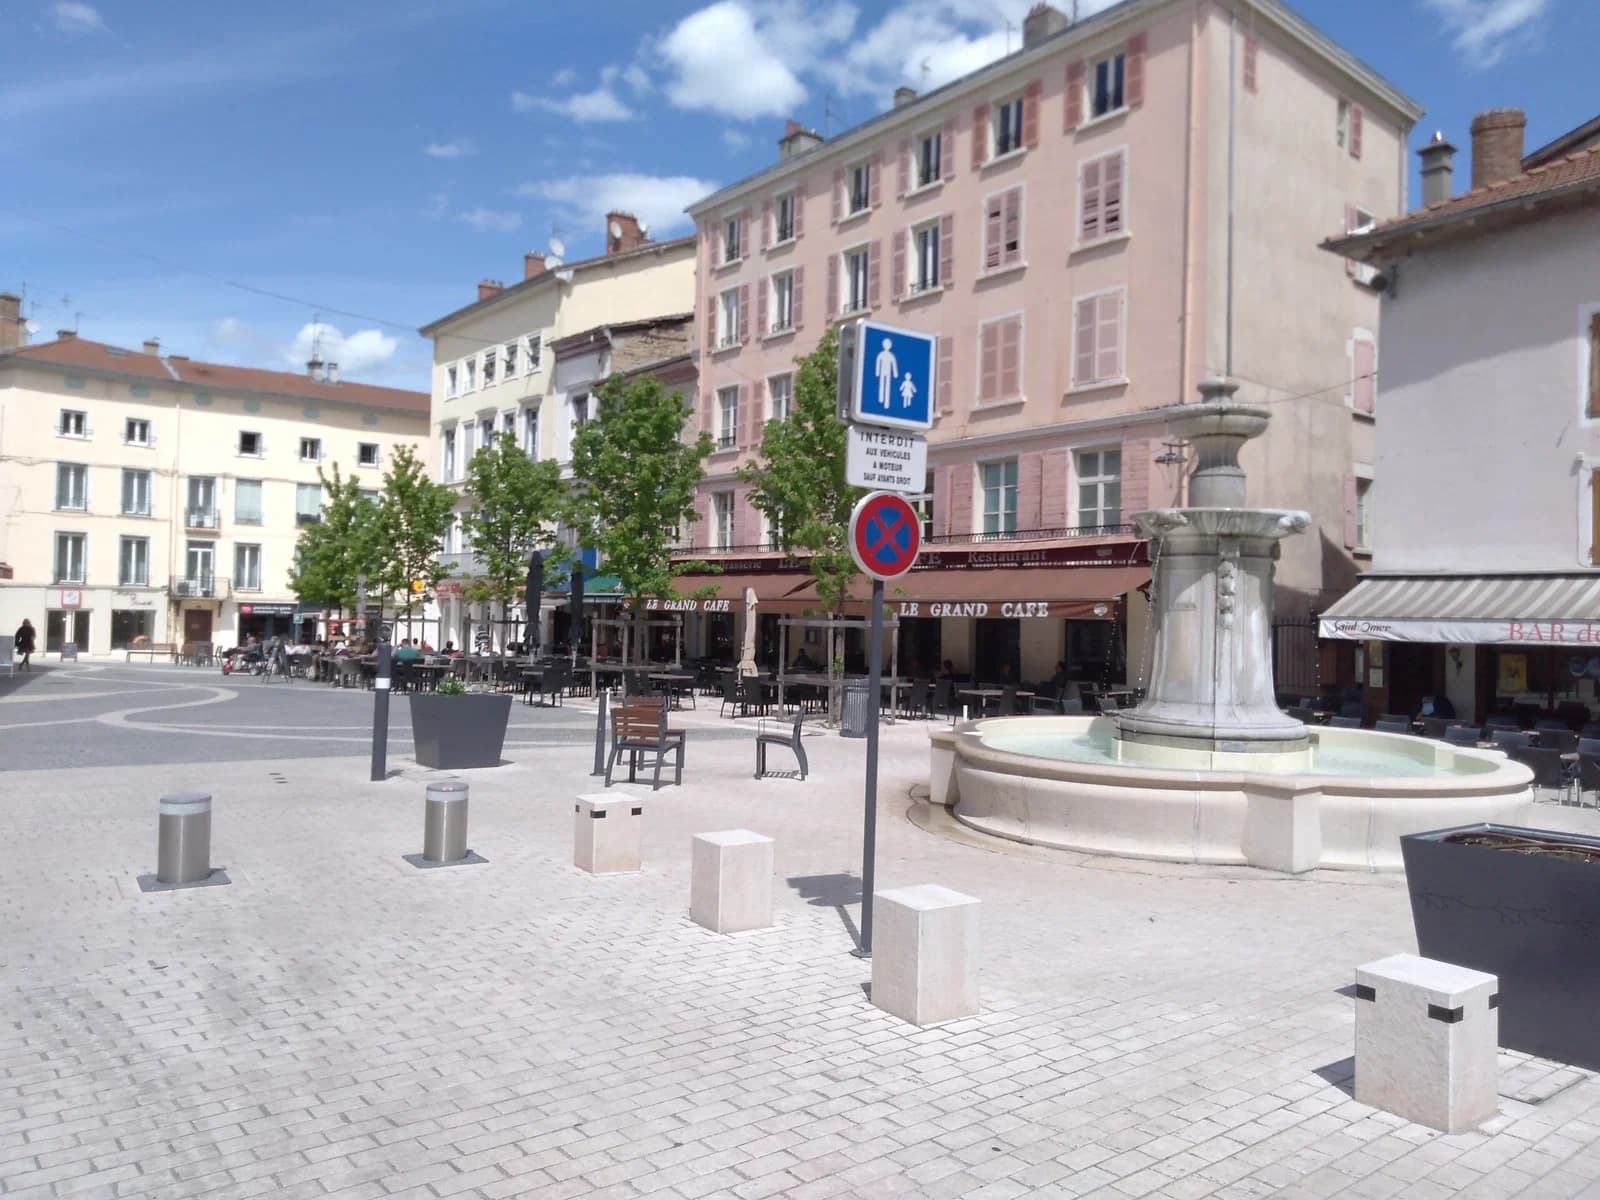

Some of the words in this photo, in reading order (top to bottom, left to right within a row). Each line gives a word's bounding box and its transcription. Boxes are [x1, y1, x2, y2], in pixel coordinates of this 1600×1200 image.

[860, 431, 915, 448] INTERDIT
[866, 448, 878, 456] AUX
[880, 449, 911, 460] VEHICULES
[873, 461, 877, 469] A
[879, 462, 903, 471] MOTEUR
[864, 472, 876, 481] SAUF
[967, 551, 1047, 564] Restaurant
[646, 599, 659, 610] LE
[664, 599, 698, 611] GRAND
[704, 600, 730, 611] CAFE
[900, 602, 919, 616] LE
[930, 602, 988, 617] GRAND
[1001, 602, 1049, 617] CAFE
[1509, 621, 1568, 642] BAR
